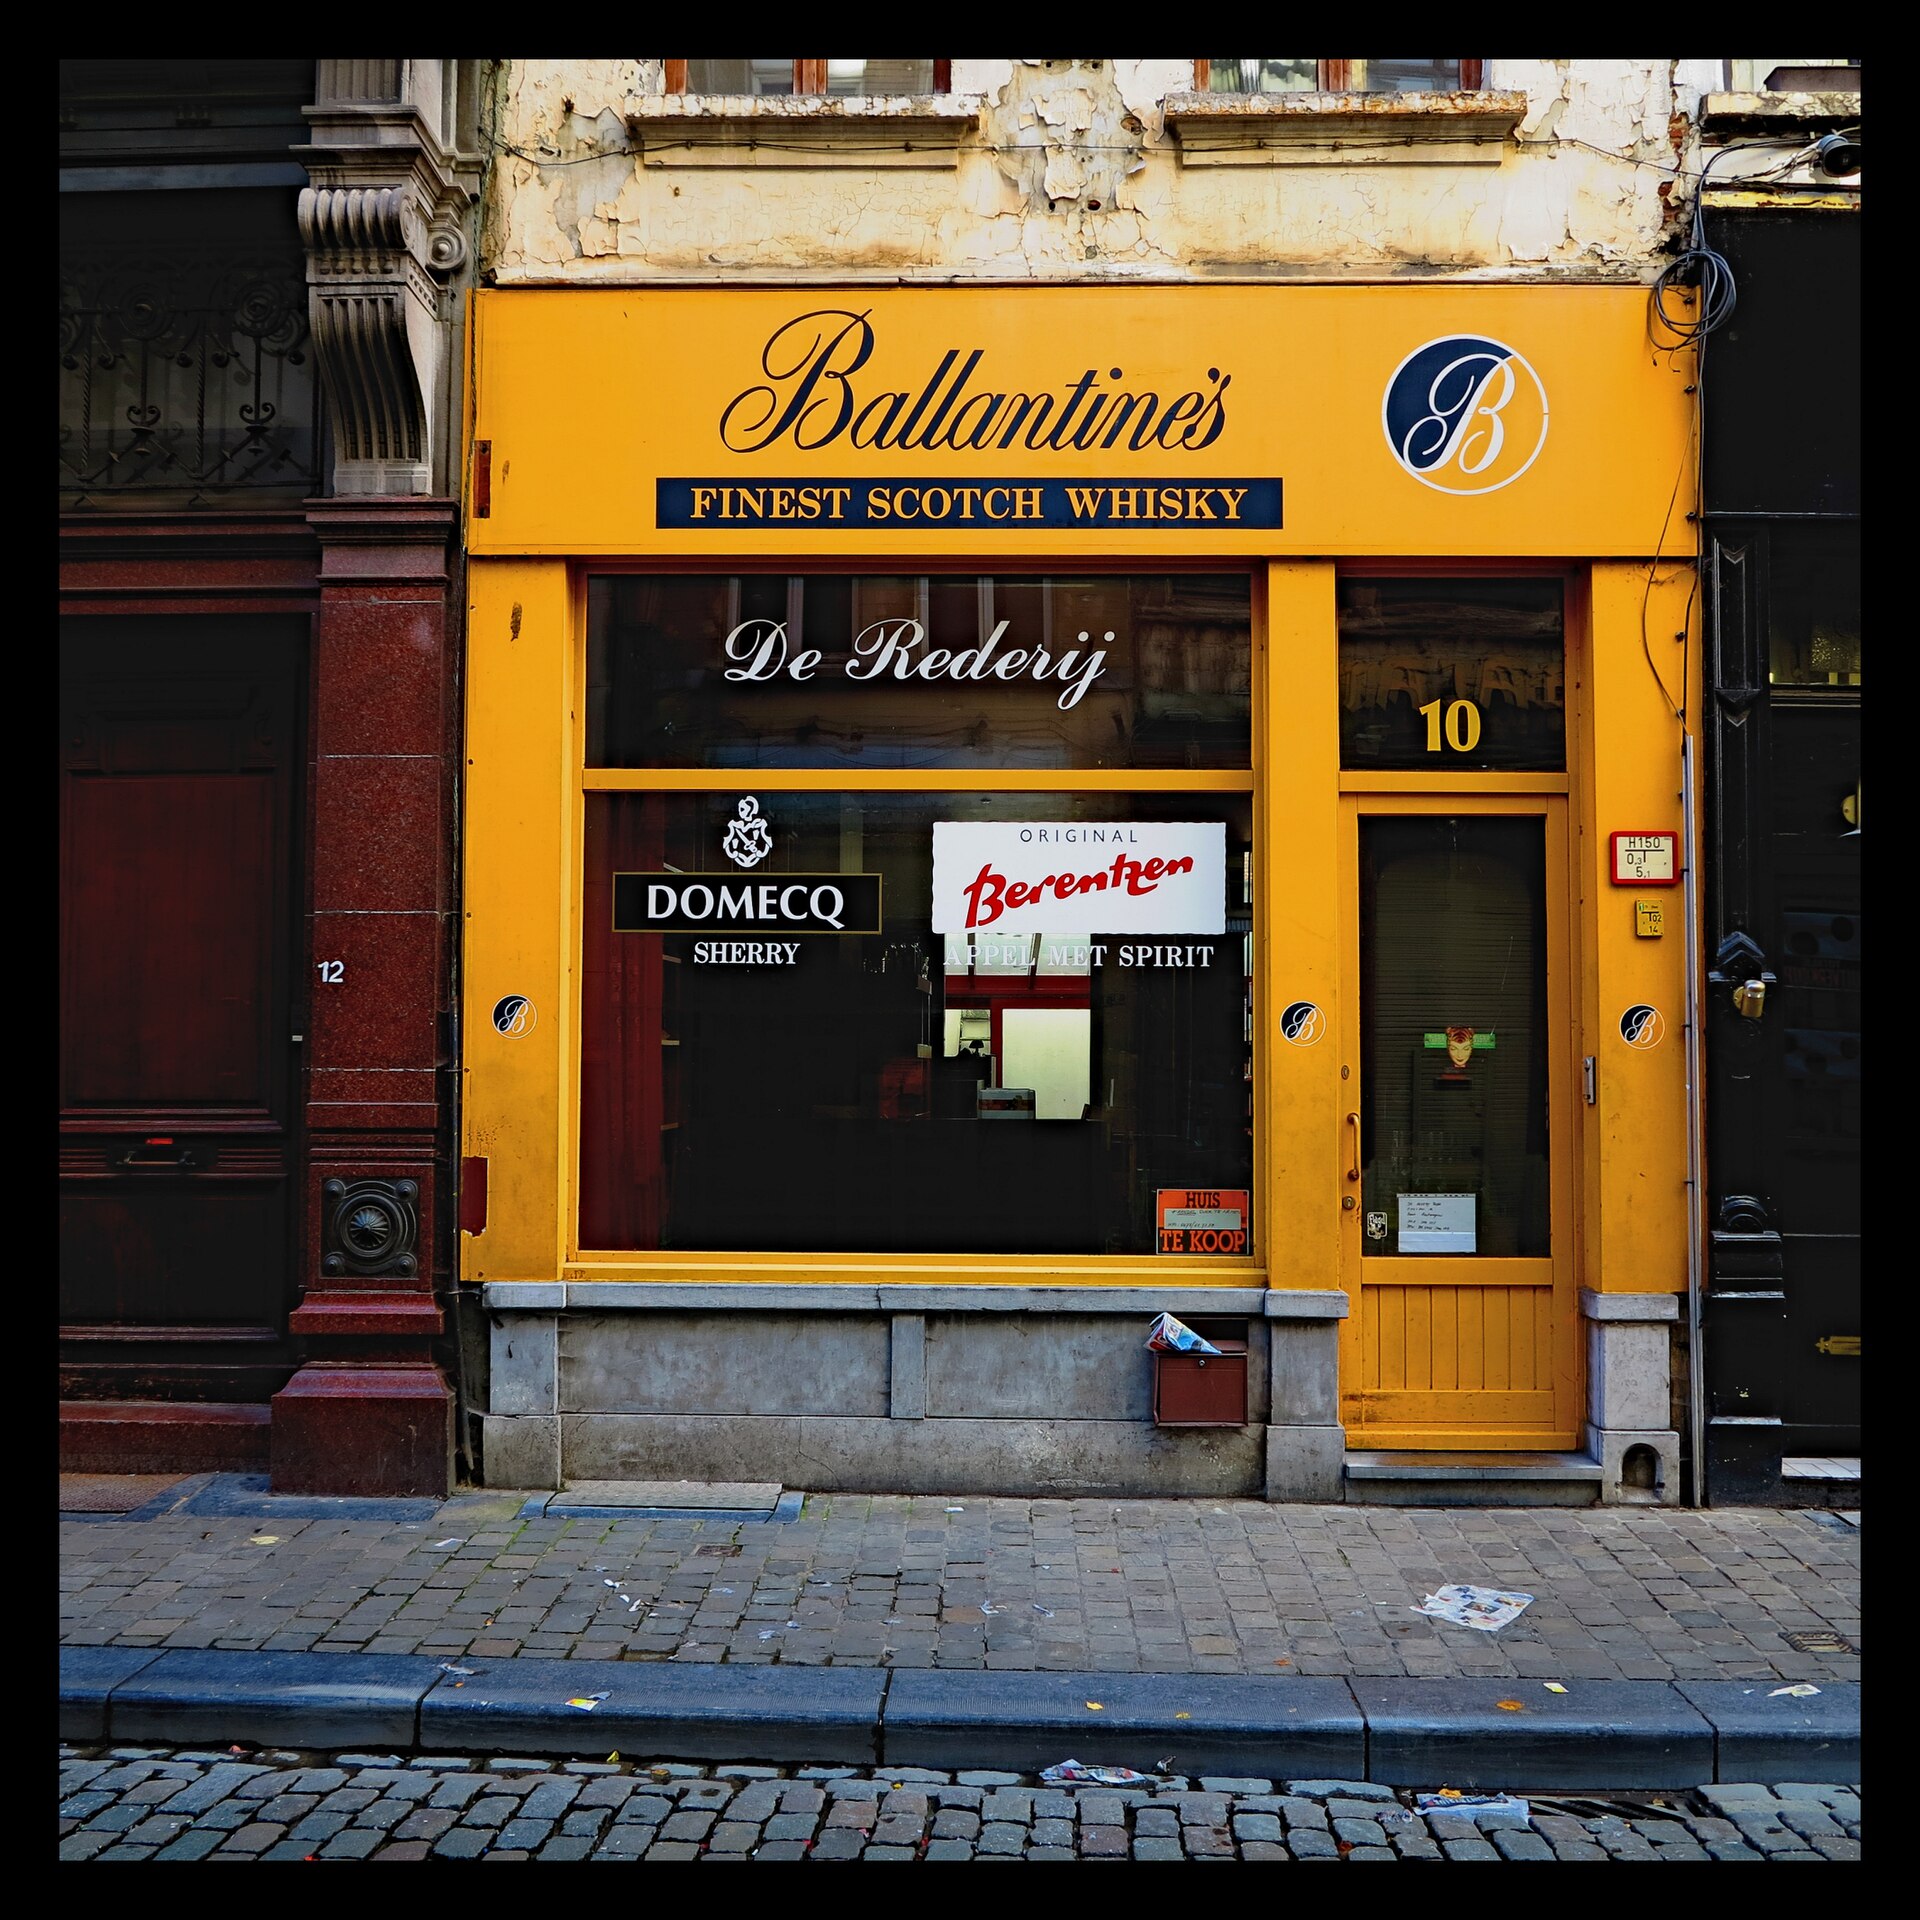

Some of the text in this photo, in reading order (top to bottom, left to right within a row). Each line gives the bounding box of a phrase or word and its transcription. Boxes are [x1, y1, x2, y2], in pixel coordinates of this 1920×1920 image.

[719, 308, 1232, 453] Ballantine's
[1403, 353, 1516, 474] B
[690, 487, 1248, 519] FINEST SCOTCH WHISKY
[724, 618, 1115, 710] De Rederij
[1418, 698, 1481, 752] 10
[1019, 828, 1138, 843] ORIGINAL
[963, 853, 1194, 928] Berentzen
[647, 884, 845, 930] DOMECQ
[693, 941, 801, 965] SHERRY
[943, 945, 1214, 967] APPEL MET SPIRIT
[317, 960, 345, 983] 12
[1185, 1191, 1221, 1208] HUIS
[1159, 1230, 1245, 1252] TE KOOP
